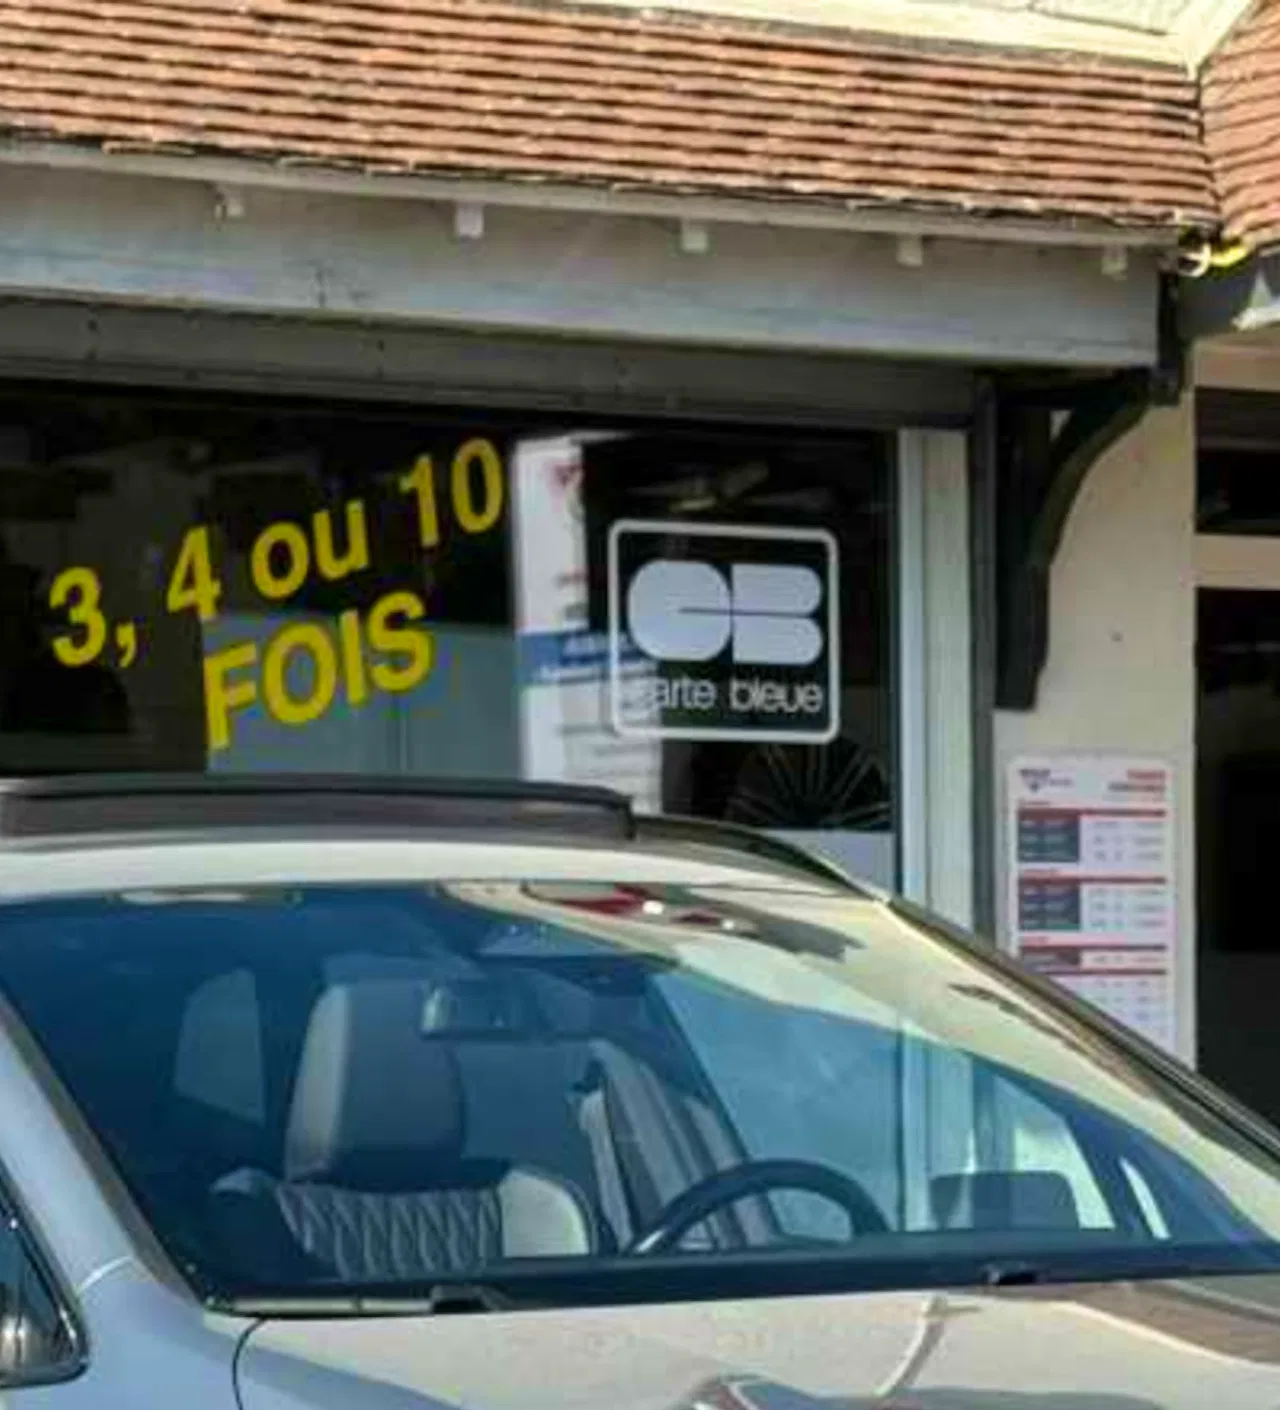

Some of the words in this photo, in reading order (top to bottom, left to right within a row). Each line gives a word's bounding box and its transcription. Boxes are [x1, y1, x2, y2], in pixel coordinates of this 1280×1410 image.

[49, 566, 138, 669] 3,
[166, 525, 222, 623] 4
[250, 499, 372, 598] ou
[399, 438, 507, 548] 10
[203, 591, 435, 751] FOIS
[728, 676, 824, 713] bleue
